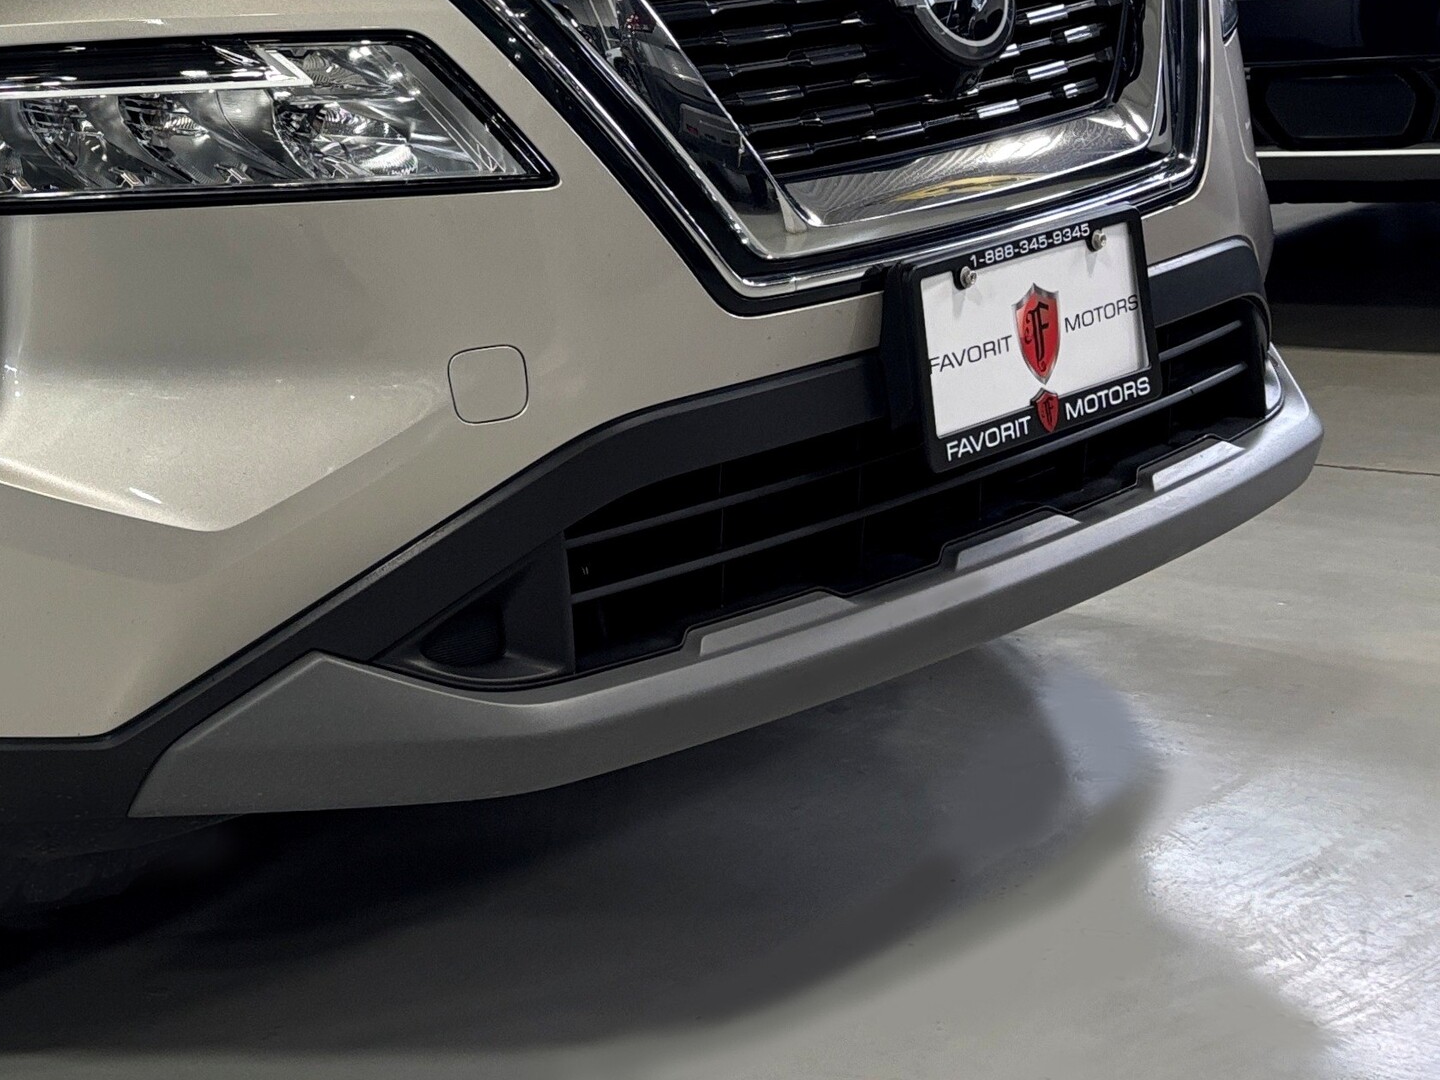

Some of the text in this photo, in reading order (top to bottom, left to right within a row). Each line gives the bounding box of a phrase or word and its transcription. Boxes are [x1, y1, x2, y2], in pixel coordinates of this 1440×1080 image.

[970, 223, 1090, 267] 1-888-345-9345
[929, 335, 1012, 374] FAVORIT
[1064, 294, 1139, 333] MOTORS
[946, 416, 1031, 461] FAVORIT
[1065, 376, 1150, 420] MOTORS
